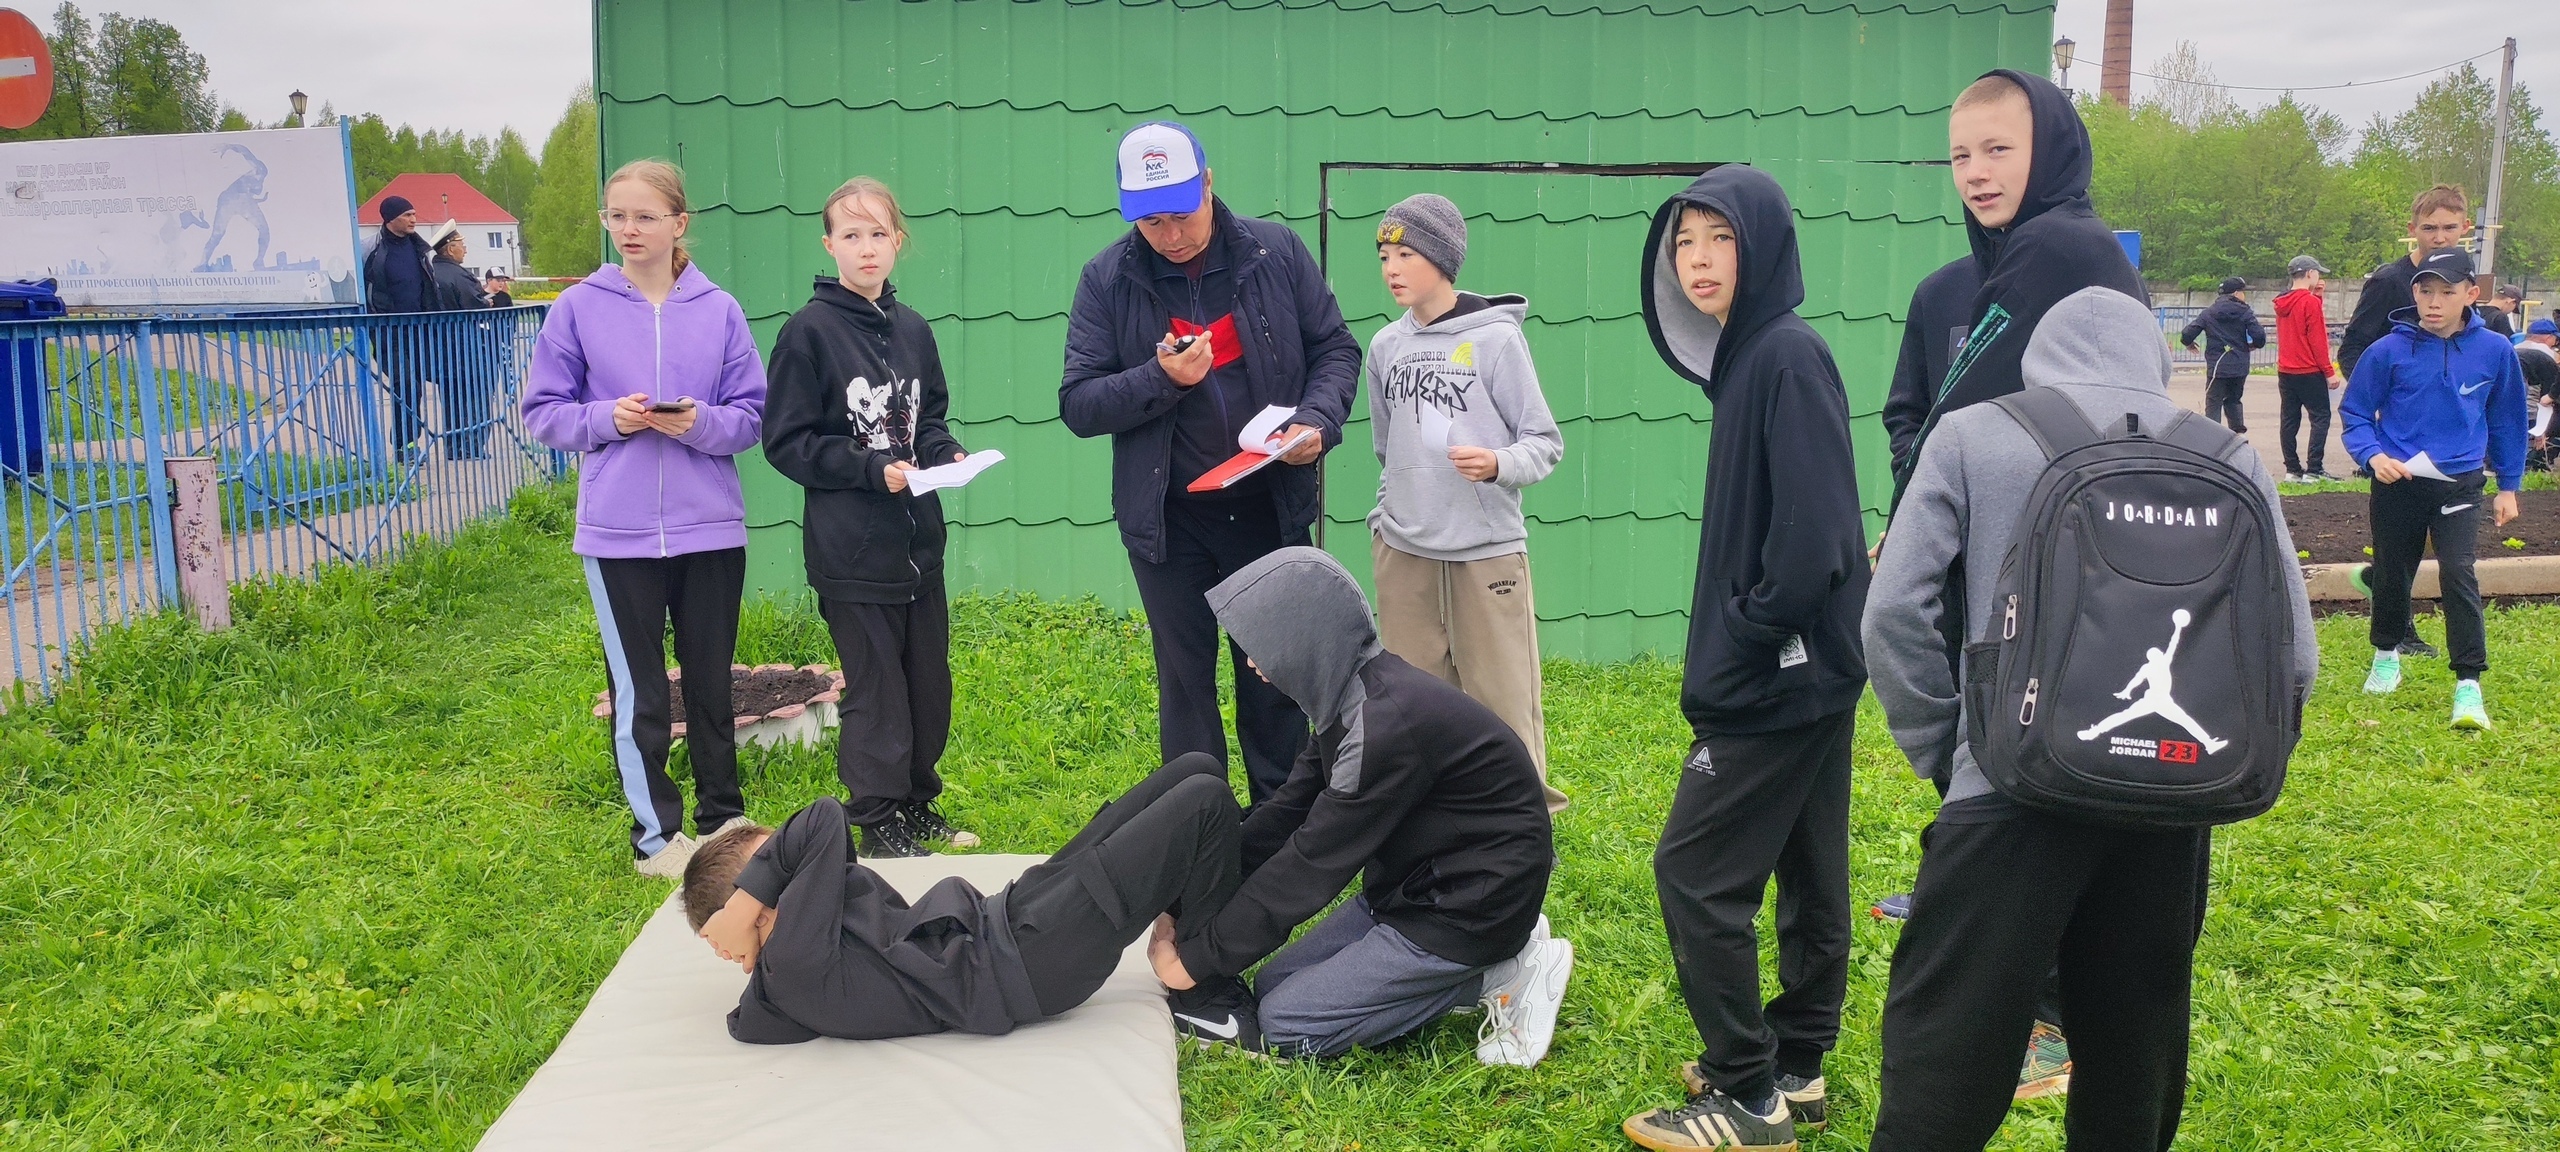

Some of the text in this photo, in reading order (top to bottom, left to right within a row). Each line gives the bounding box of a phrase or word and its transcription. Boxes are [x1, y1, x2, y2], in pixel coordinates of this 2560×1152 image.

[40, 163, 56, 179] ДО
[1145, 169, 1169, 178] ЕДИНАЯ
[1146, 174, 1170, 182] РОССИЯ
[89, 174, 127, 190] РАЙОН
[136, 195, 197, 217] трасса
[2110, 736, 2158, 749] MICHAEL
[2108, 743, 2193, 760] JORDAN 23
